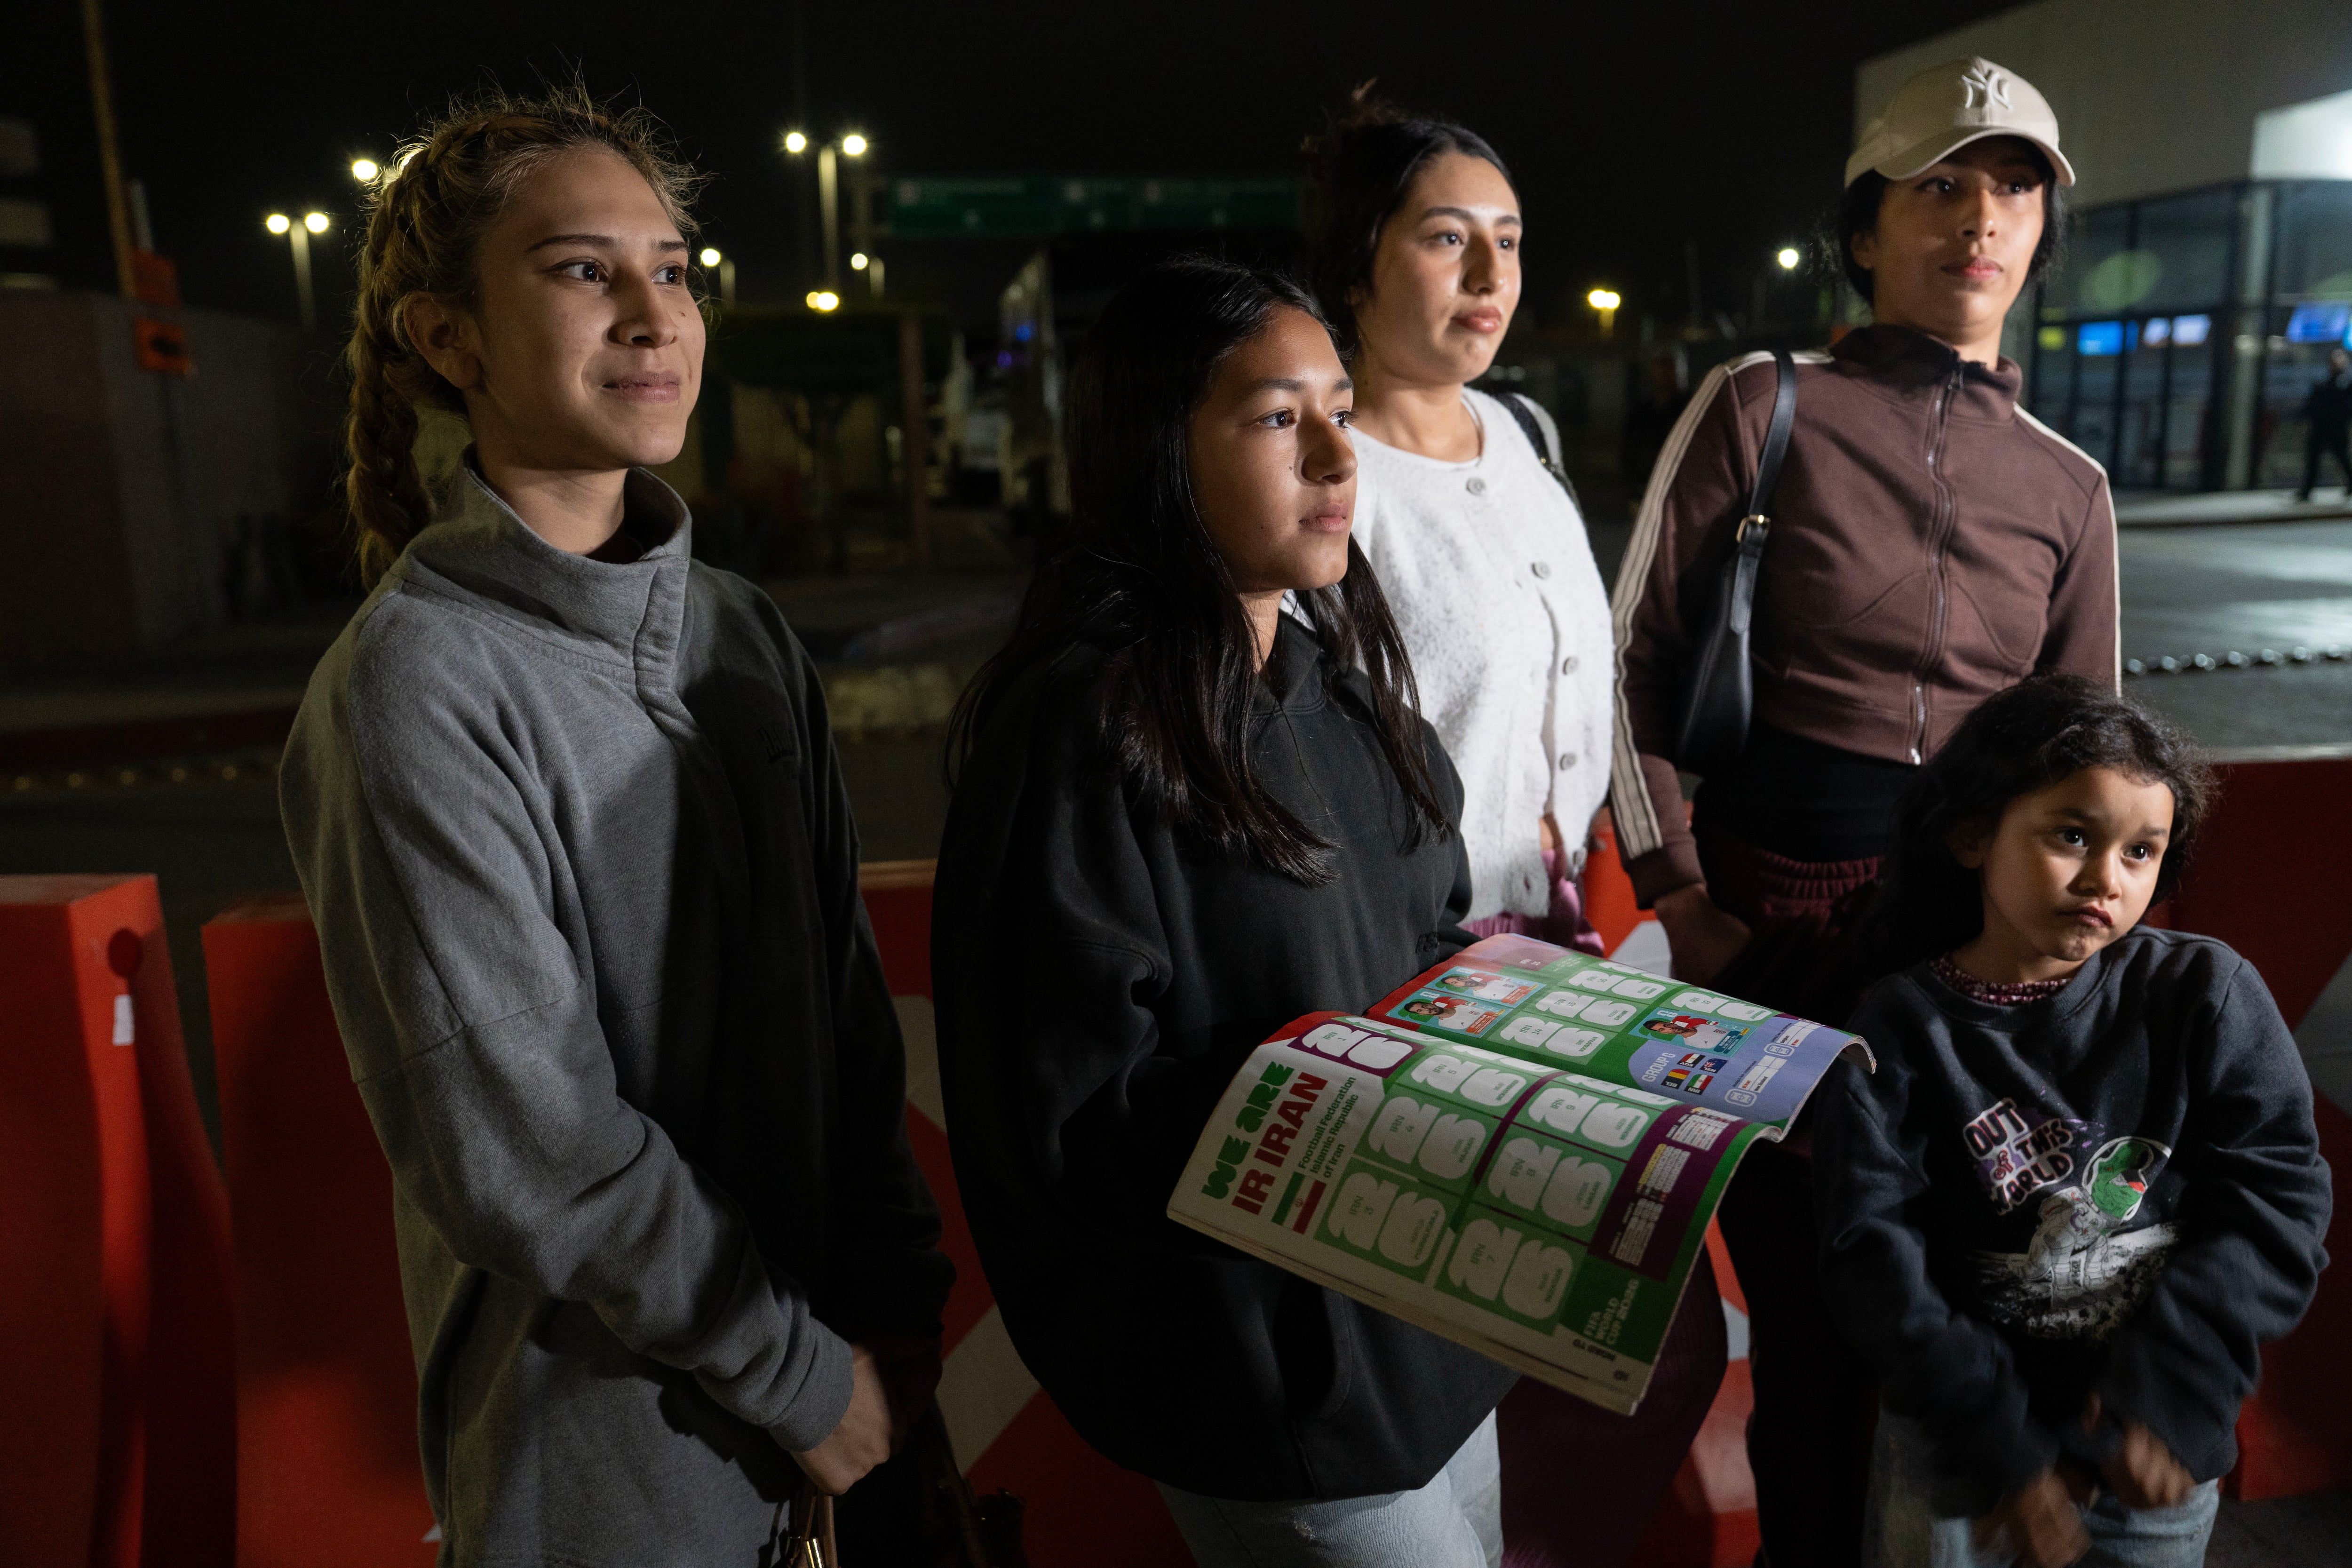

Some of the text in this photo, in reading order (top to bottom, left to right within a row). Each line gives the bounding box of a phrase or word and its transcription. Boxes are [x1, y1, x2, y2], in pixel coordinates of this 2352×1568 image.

[1962, 67, 2014, 110] NY
[1323, 1031, 1338, 1040] IRN
[1518, 1025, 1532, 1033] IRN
[1432, 1064, 1448, 1074] IRN
[1642, 1057, 1669, 1082] GROUP
[1550, 1098, 1565, 1109] IRN
[1201, 1061, 1294, 1199] WE ARE
[1298, 1076, 1356, 1168] Football Federation
[1310, 1094, 1359, 1173] Islamic Republic
[1390, 1114, 1406, 1133] IRN
[1964, 1102, 2025, 1157] OUT
[1232, 1072, 1328, 1215] IR IRAN
[1323, 1143, 1345, 1178] of Iran
[1510, 1158, 1525, 1177] IRN
[1994, 1150, 2013, 1181] of
[1350, 1195, 1365, 1216] IRN
[1470, 1243, 1486, 1265] IRN
[1583, 1311, 1601, 1336] FIFA
[1595, 1297, 1620, 1341] WORLD
[1606, 1319, 1621, 1345] CUP
